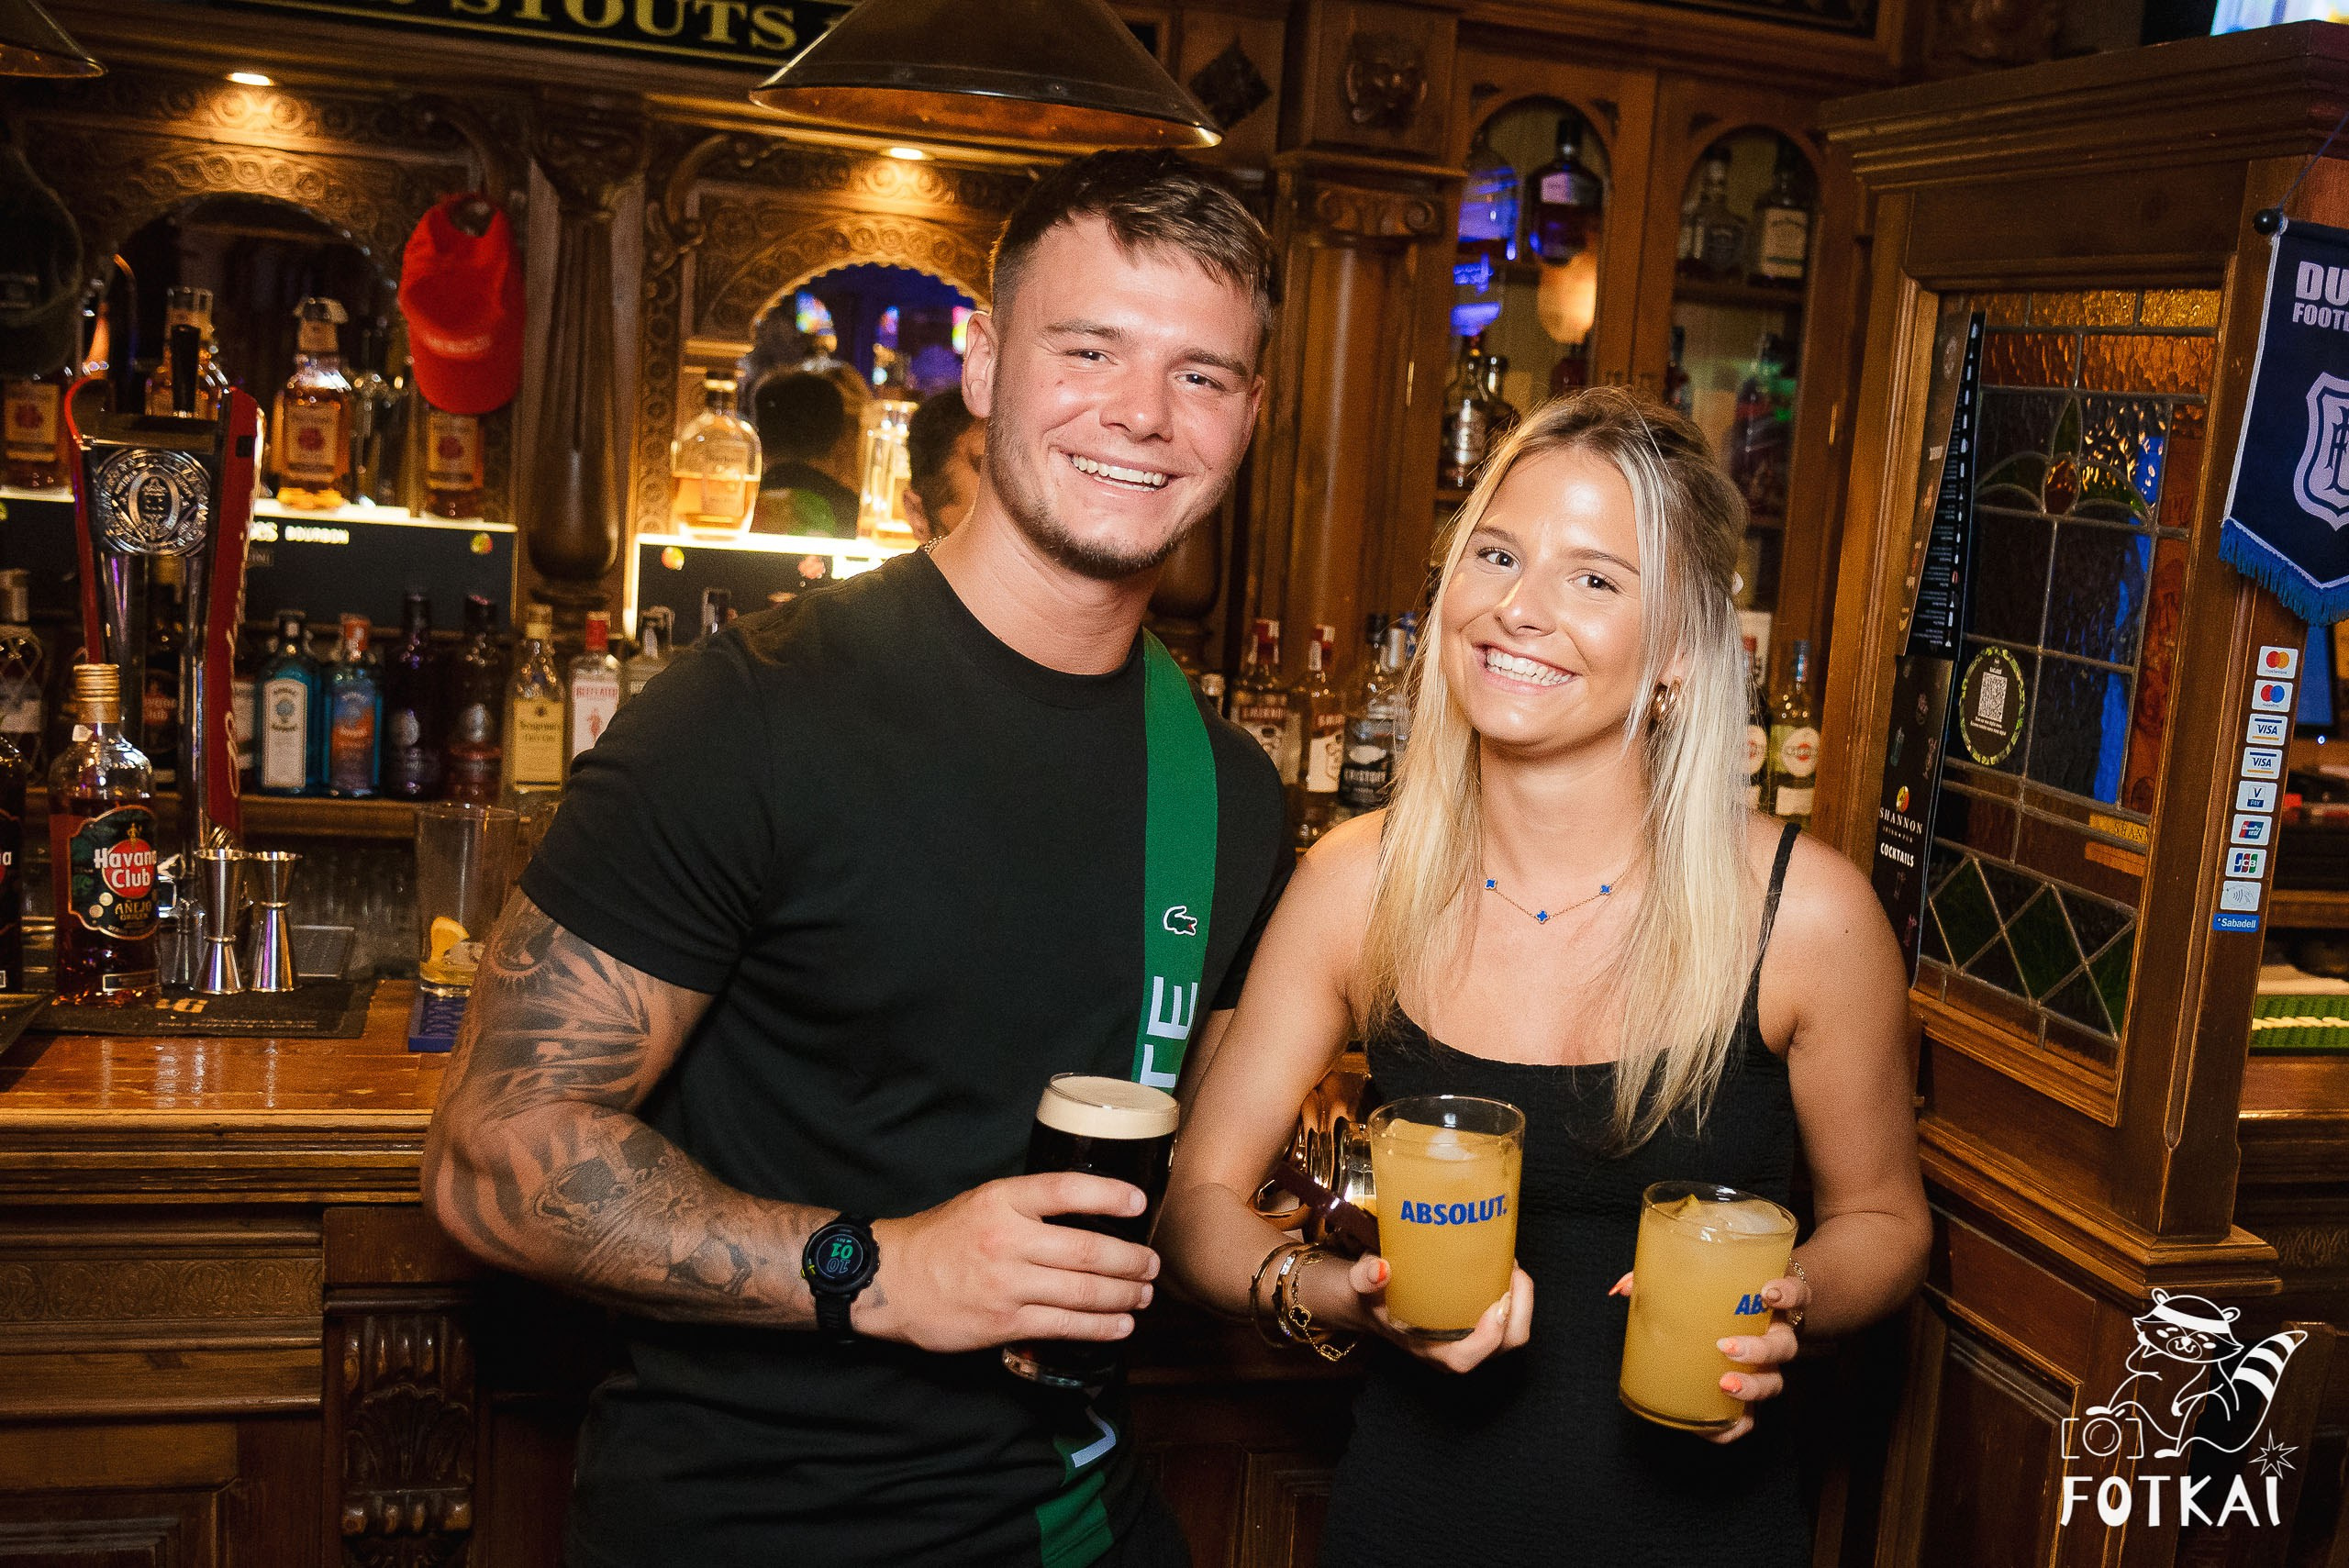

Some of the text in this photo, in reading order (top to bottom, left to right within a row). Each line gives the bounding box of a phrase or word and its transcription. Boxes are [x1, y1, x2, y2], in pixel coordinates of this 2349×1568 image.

[453, 0, 797, 51] OUTS
[2257, 724, 2277, 735] VISA
[2252, 757, 2272, 768] VISA
[1879, 807, 1923, 835] SHANNON
[1880, 842, 1914, 867] COCKTAILS
[2235, 858, 2257, 867] JCB
[111, 868, 151, 888] Club
[2221, 917, 2256, 929] Sabadell
[1734, 1294, 1768, 1315] AB
